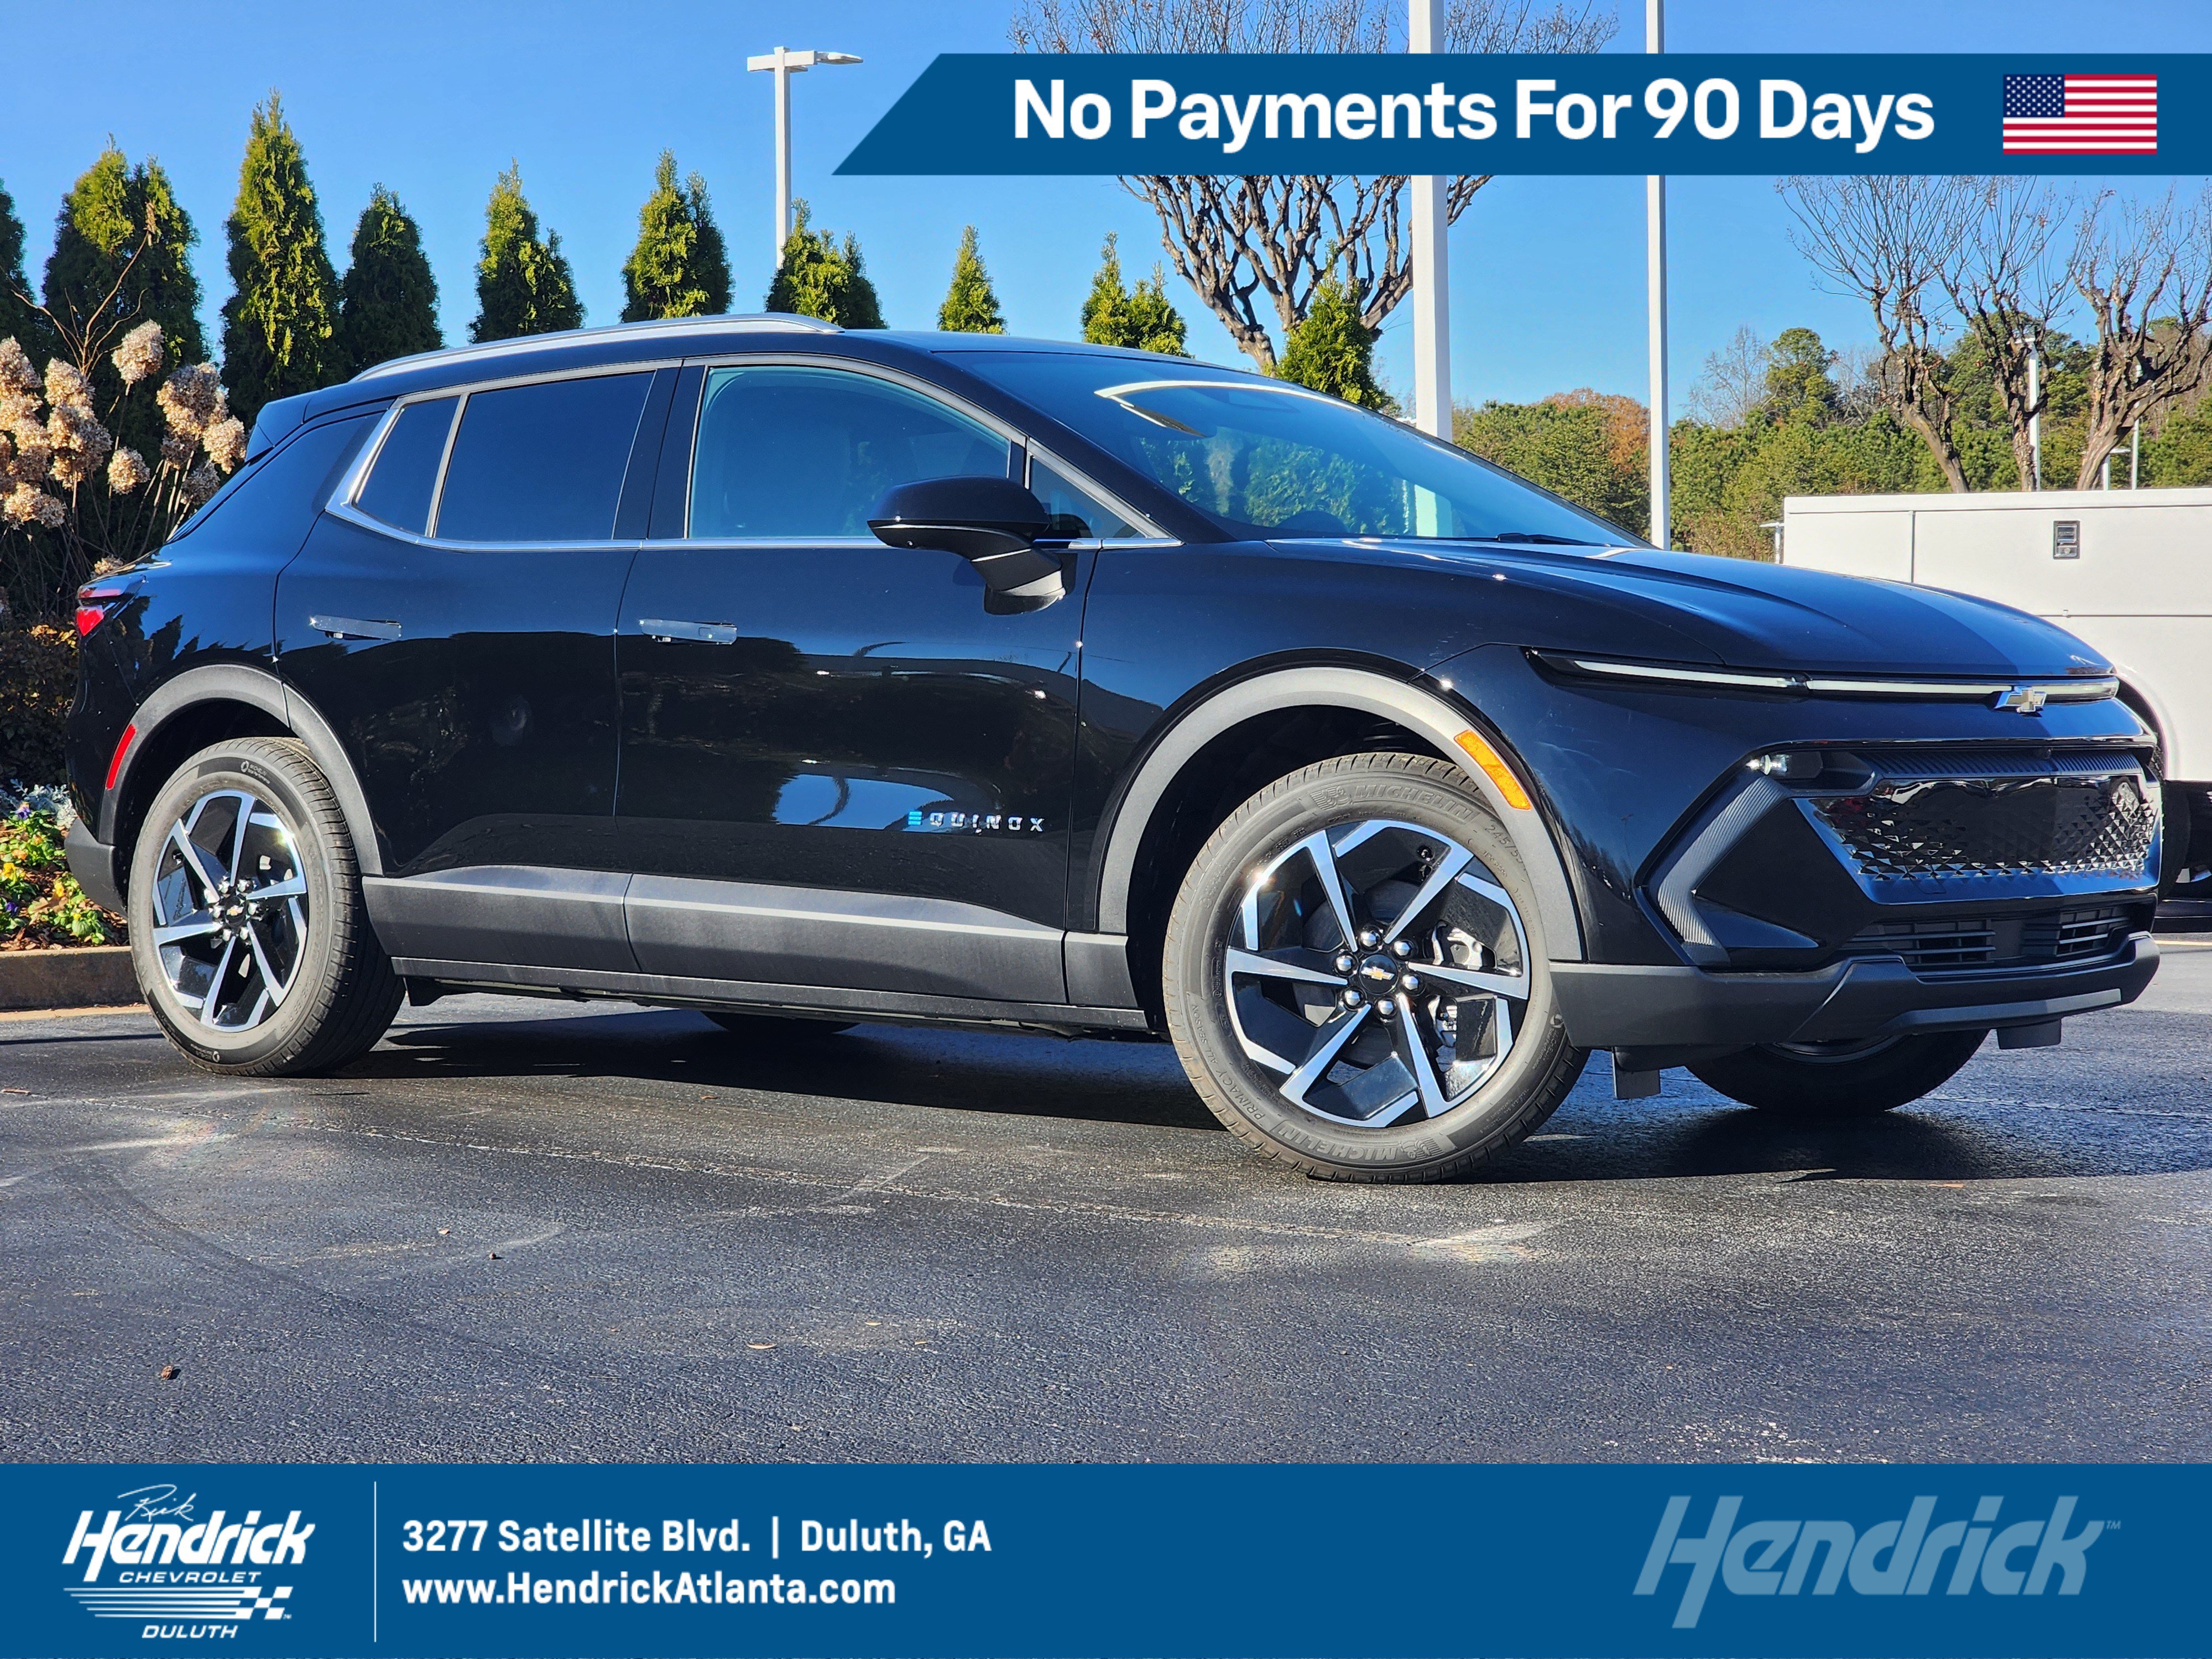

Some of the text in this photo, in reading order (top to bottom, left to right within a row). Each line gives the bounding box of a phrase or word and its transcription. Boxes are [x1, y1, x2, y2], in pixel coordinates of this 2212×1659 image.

[907, 811, 1045, 832] EQUINOX
[1355, 784, 1474, 823] MICHELIN
[1192, 1004, 1208, 1044] SEASON
[1206, 1050, 1217, 1064] ALL
[1216, 1068, 1265, 1120] PRIMACY
[1277, 1125, 1398, 1160] MICHELIN
